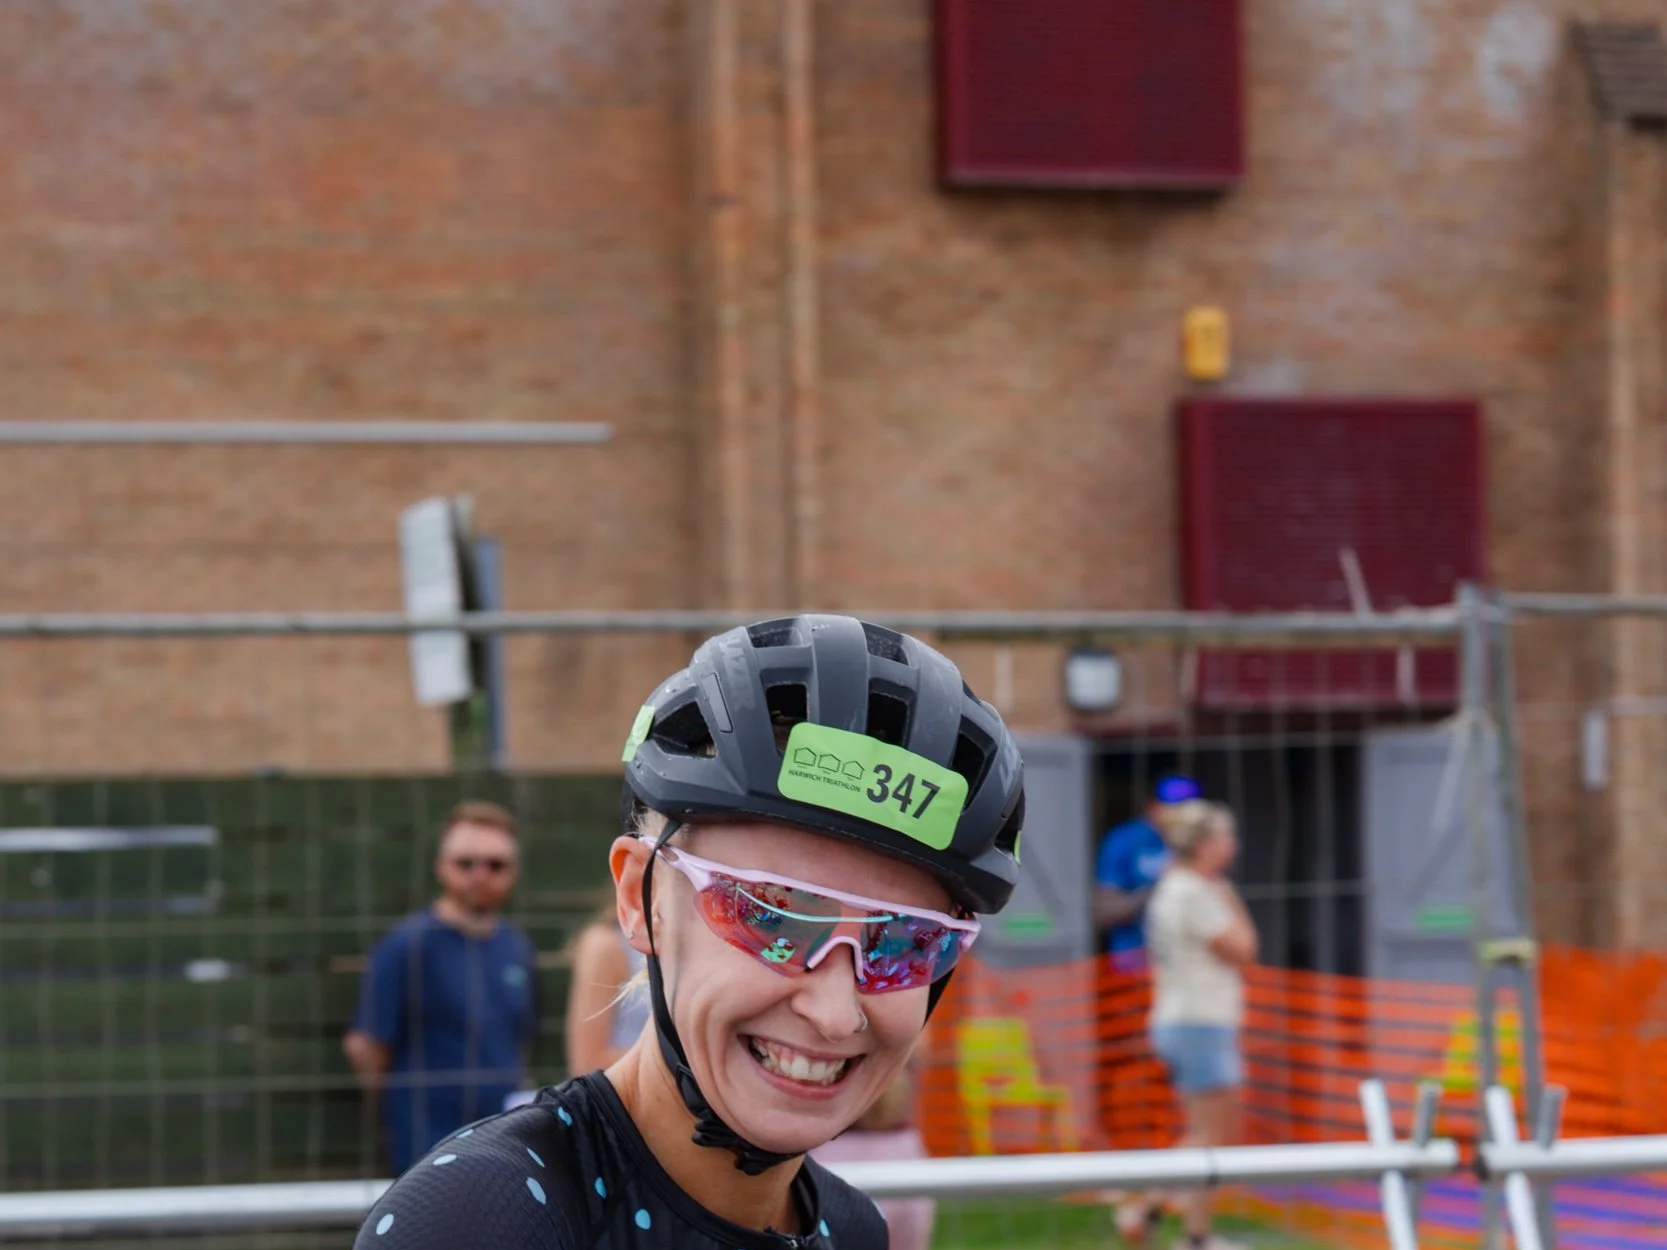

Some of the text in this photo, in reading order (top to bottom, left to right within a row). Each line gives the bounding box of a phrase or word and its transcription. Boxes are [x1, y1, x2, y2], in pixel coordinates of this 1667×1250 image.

[788, 768, 821, 781] HARWICH
[823, 776, 861, 792] TRIATHLON
[867, 763, 941, 820] 347
